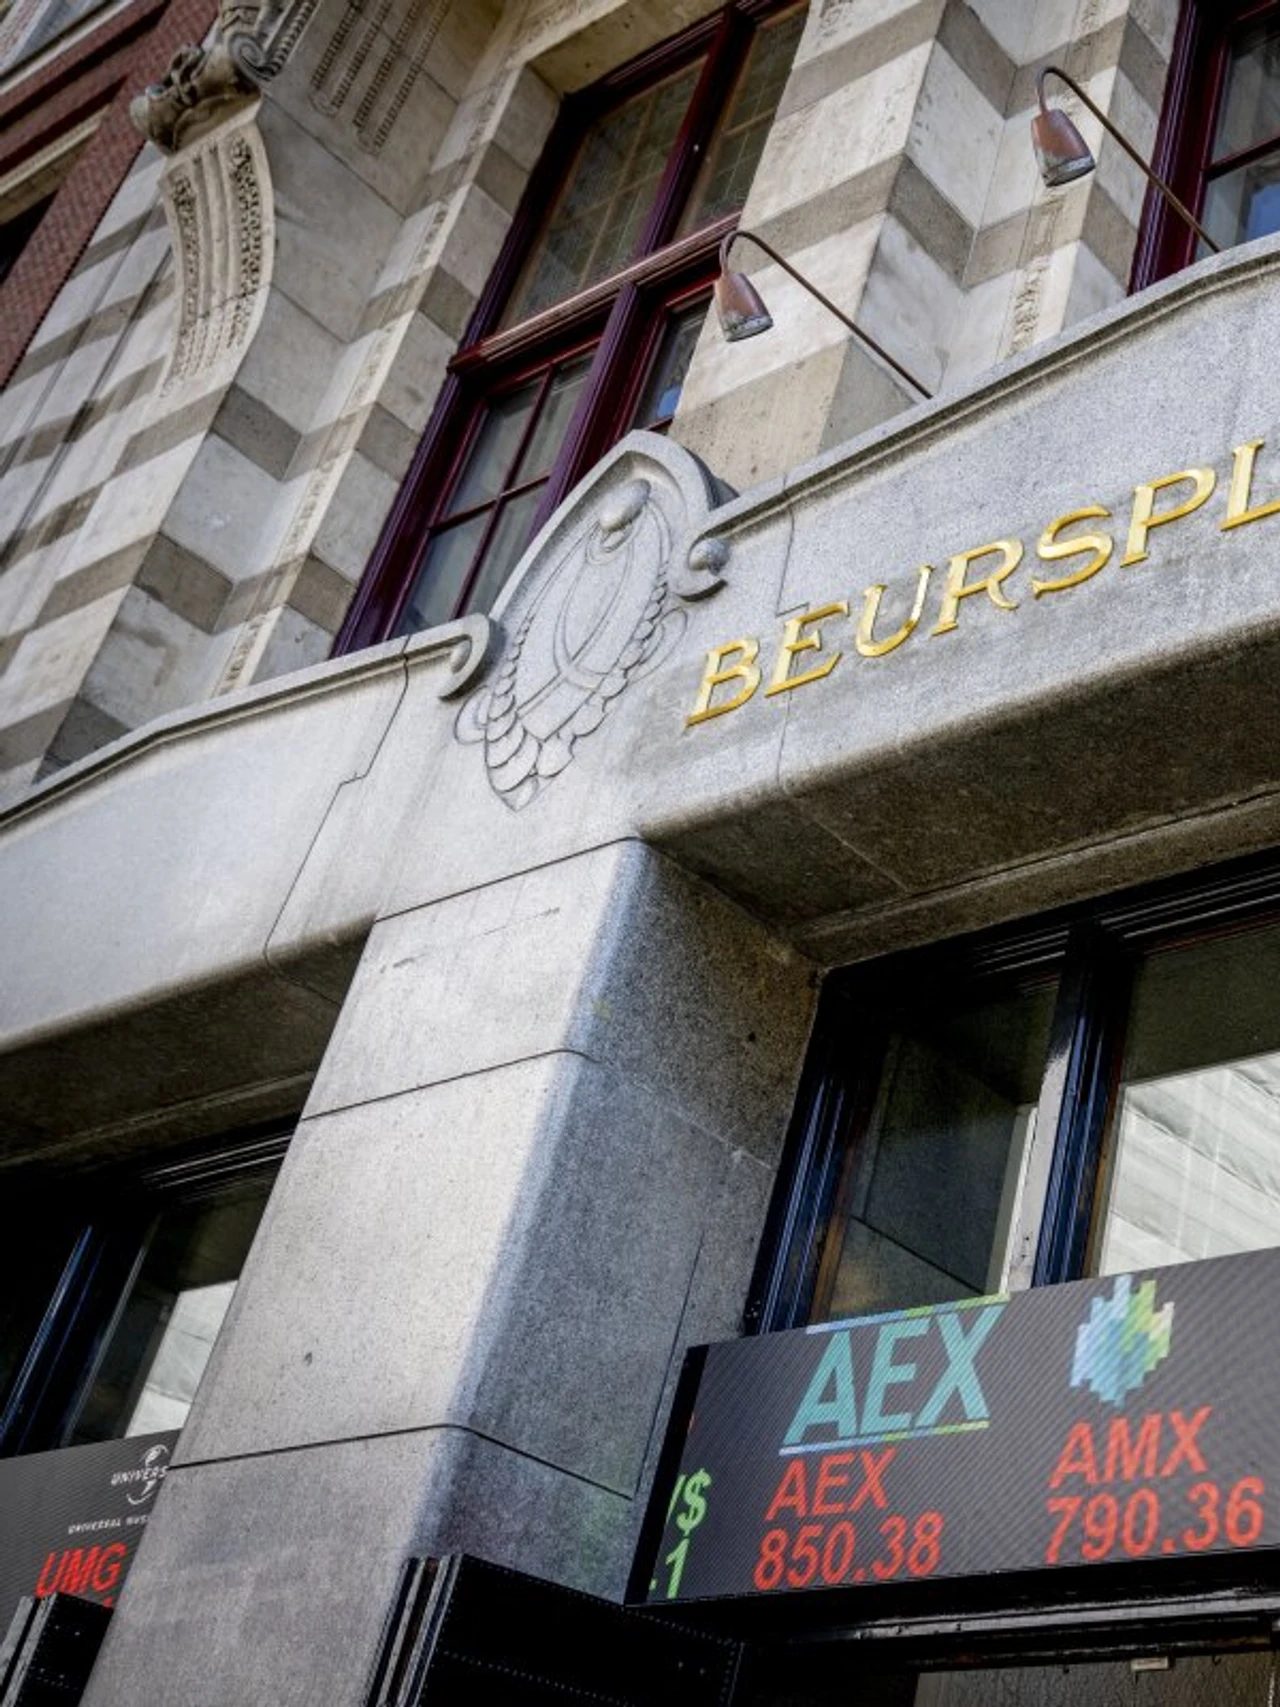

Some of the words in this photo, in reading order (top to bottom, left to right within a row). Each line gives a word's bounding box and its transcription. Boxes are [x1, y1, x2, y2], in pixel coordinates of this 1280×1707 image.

[782, 1301, 1008, 1447] AEX
[765, 1447, 896, 1520] AEX
[1049, 1405, 1212, 1489] AMX
[753, 1511, 944, 1592] 850.38
[1045, 1476, 1265, 1566] 790.36
[34, 1542, 127, 1599] UMG
